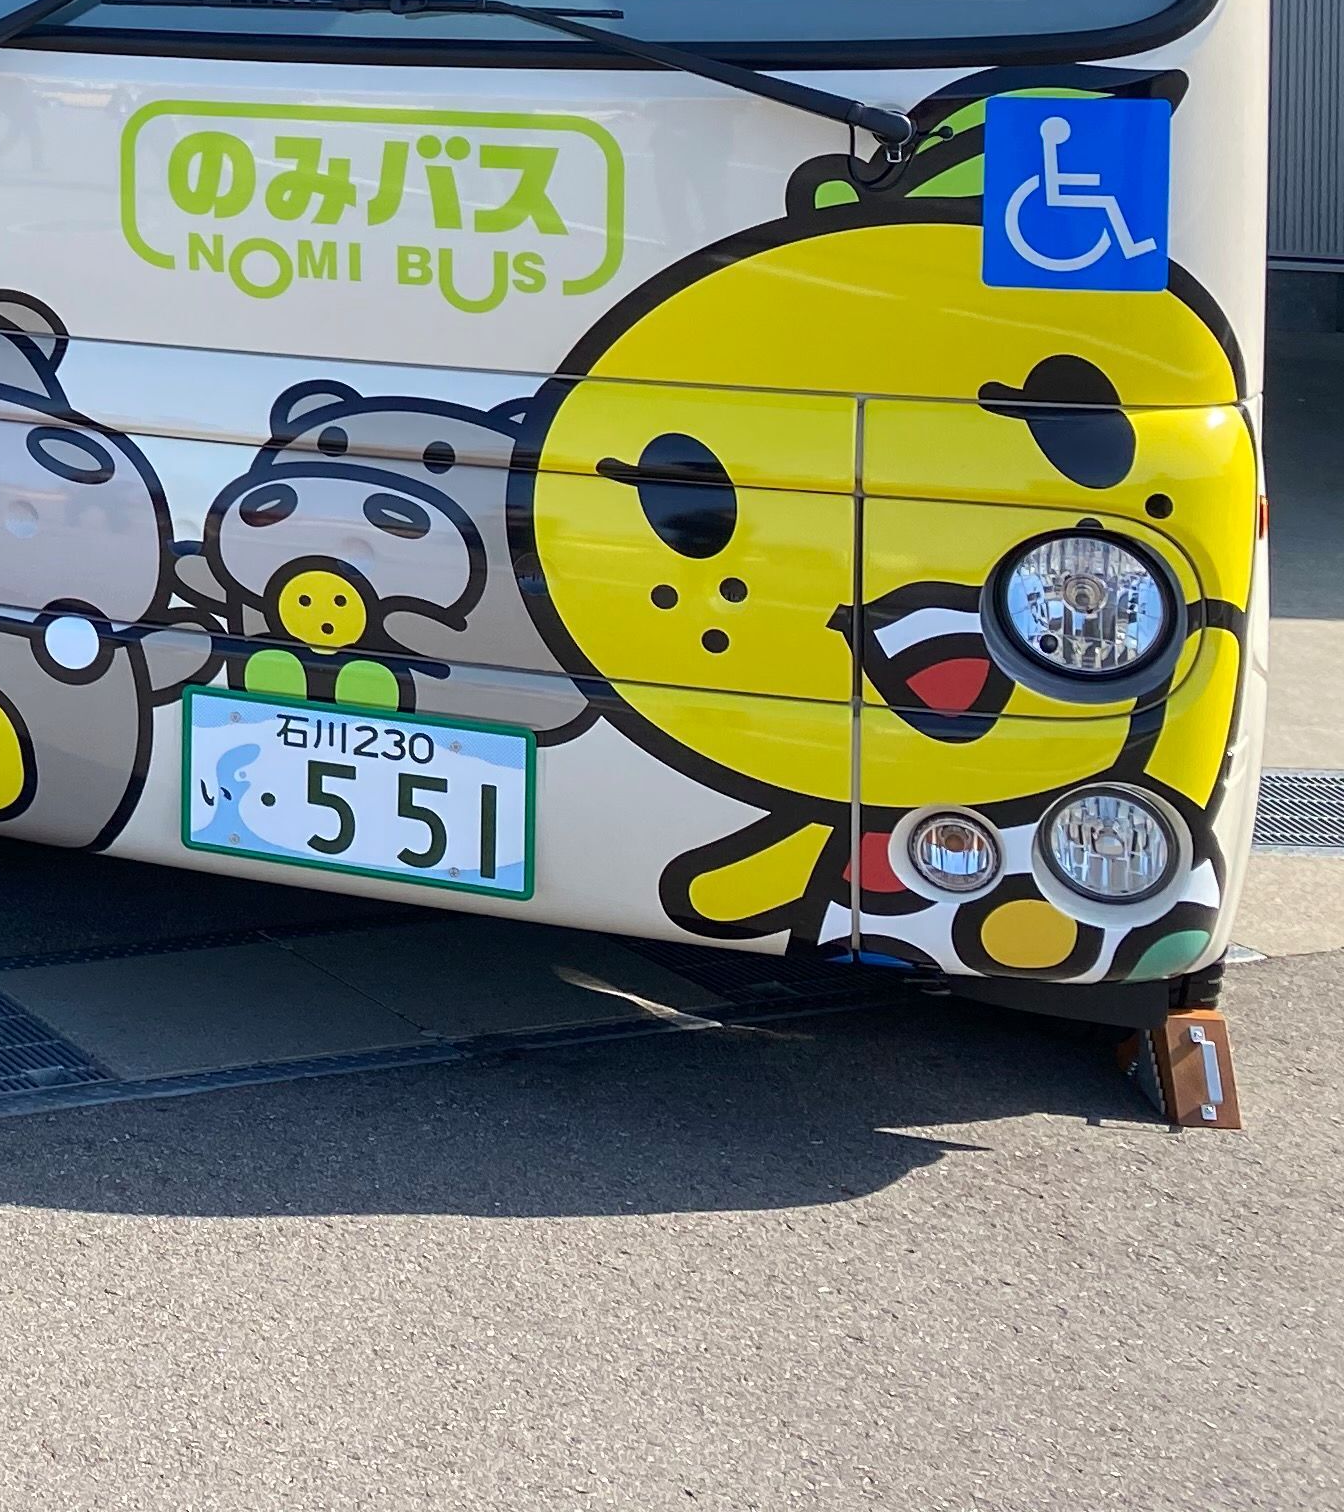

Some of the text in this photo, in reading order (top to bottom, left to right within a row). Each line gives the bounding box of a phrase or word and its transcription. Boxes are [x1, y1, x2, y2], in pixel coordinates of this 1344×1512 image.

[167, 131, 570, 236] のみバス
[188, 232, 547, 314] NOMI BUS
[276, 714, 435, 764] 石川230
[200, 778, 232, 807] い
